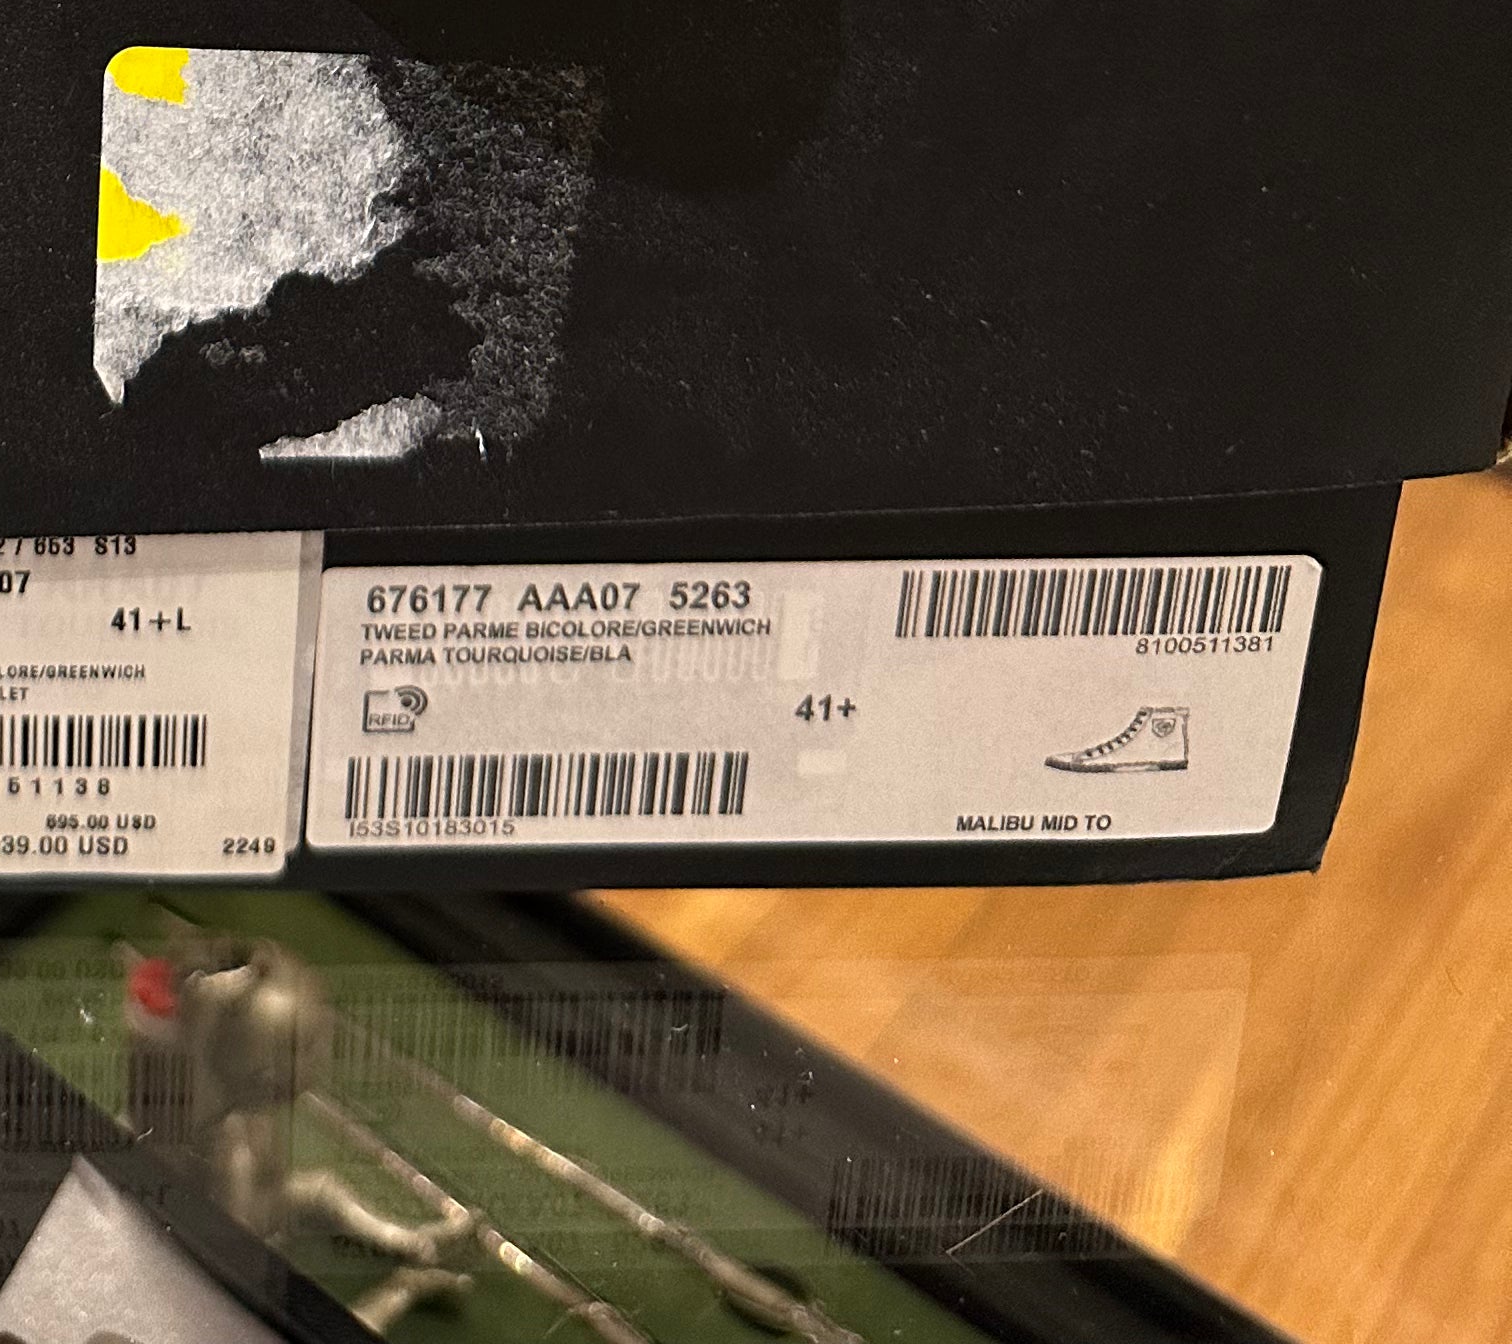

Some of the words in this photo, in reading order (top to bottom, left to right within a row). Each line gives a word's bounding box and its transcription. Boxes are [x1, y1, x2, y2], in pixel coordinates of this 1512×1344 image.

[367, 585, 492, 615] 676177
[518, 583, 640, 612] AAA07
[670, 581, 750, 611] 5263
[361, 623, 437, 641] TWEED
[443, 623, 518, 640] PARME
[526, 619, 771, 640] BICOLORE/GREENWICH
[360, 648, 436, 666] PARMA
[443, 645, 633, 665] TOURQUOISE/BLA
[1135, 636, 1274, 655] 8100511381
[795, 695, 856, 722] 41+
[369, 714, 410, 725] RFID
[117, 815, 156, 831] USD
[956, 816, 1034, 831] MALIBU
[1041, 815, 1078, 831] MID
[1085, 815, 1112, 831] TO
[79, 836, 128, 857] USD
